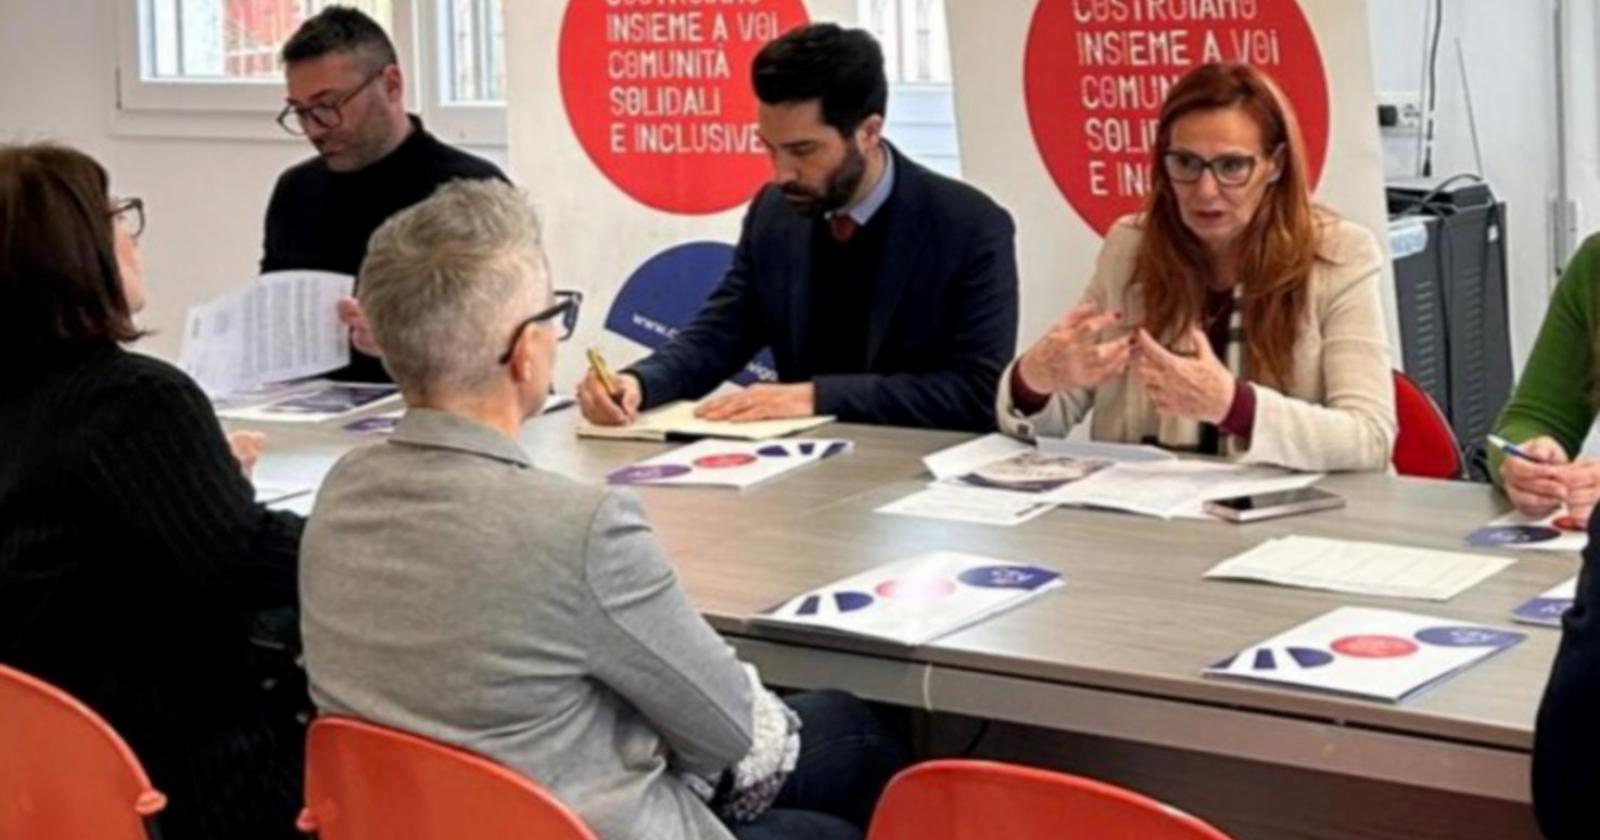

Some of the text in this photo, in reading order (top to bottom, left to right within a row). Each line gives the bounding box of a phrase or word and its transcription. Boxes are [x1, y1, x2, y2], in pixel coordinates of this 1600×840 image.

[607, 12, 778, 42] INSIEME A VOI
[608, 43, 730, 79] COMUNITÀ
[1076, 29, 1280, 65] INSIEME A VOI
[610, 86, 721, 116] SOLIDALI
[1081, 75, 1179, 109] COMUN
[610, 124, 762, 154] E INCLUSIVE
[1089, 161, 1109, 196] E
